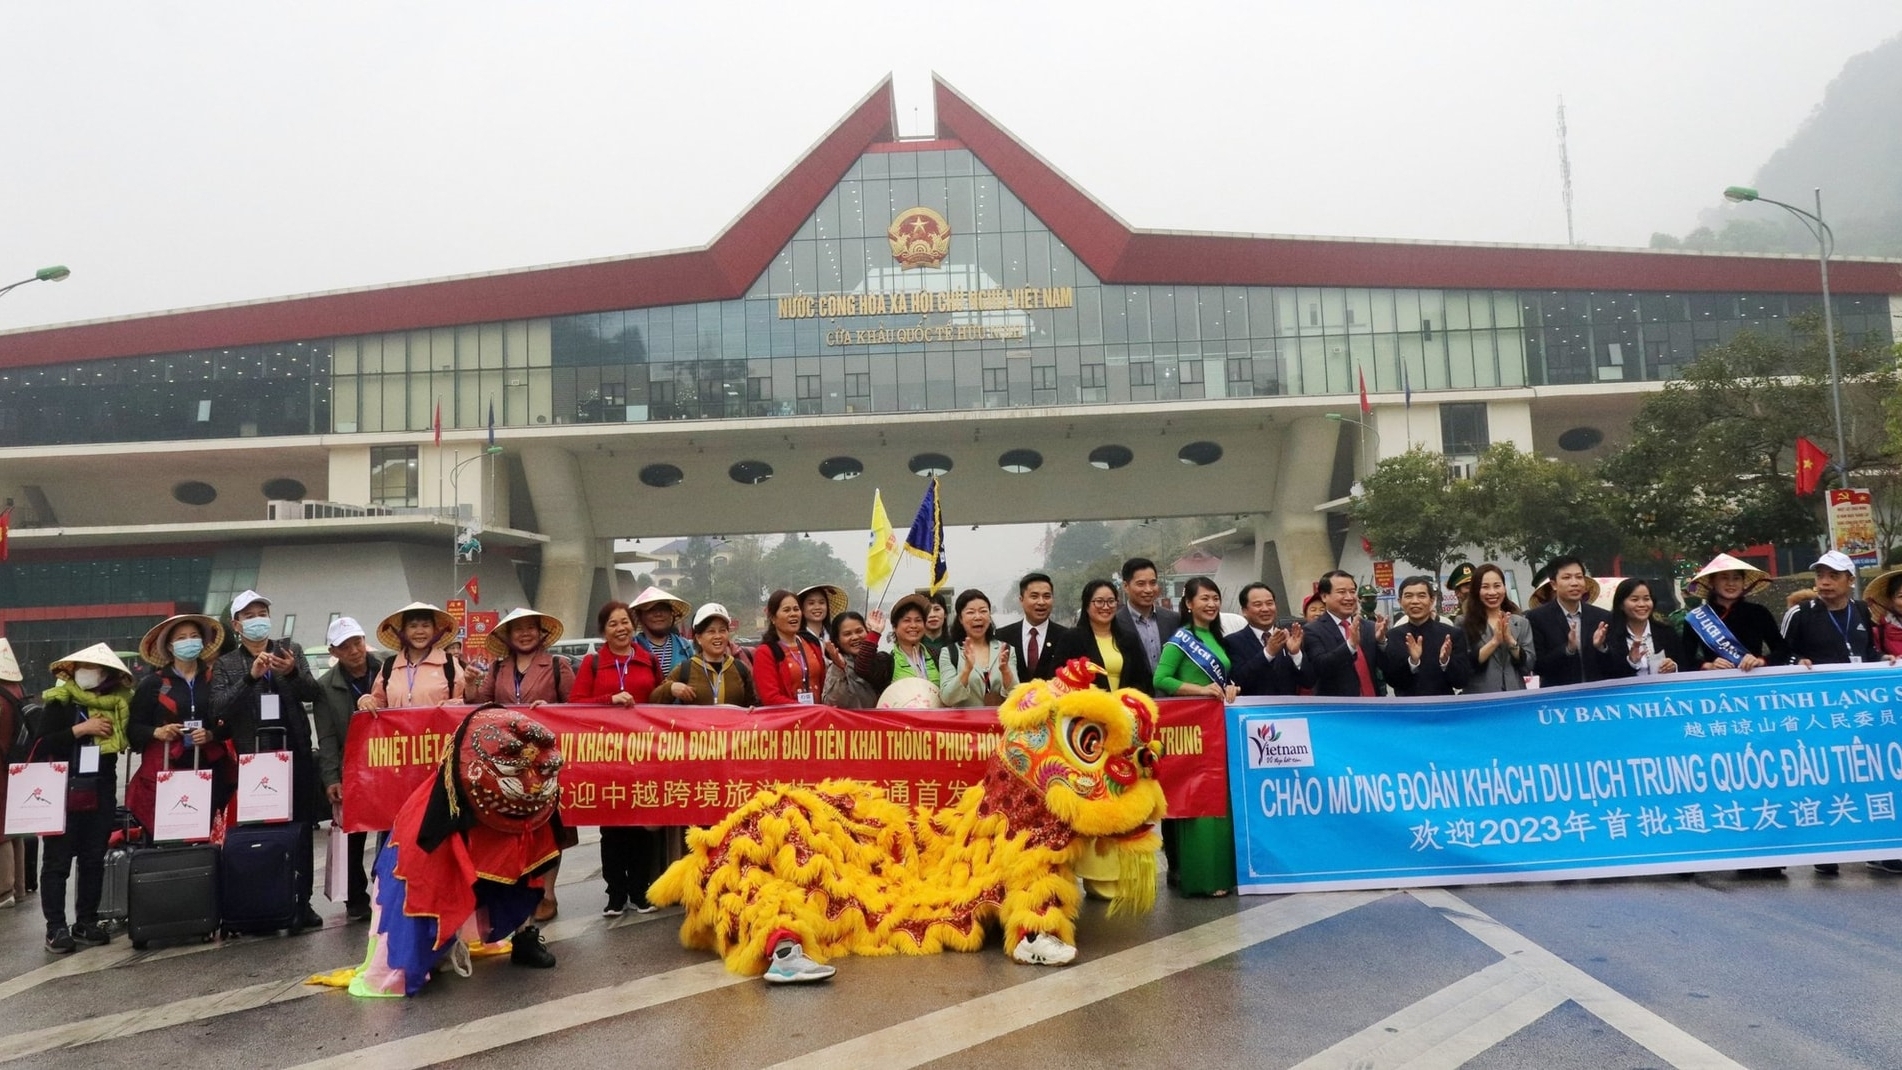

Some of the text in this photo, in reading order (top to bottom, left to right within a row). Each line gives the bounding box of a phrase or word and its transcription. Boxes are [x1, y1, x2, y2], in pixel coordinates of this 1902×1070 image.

[778, 290, 816, 319] NƯỚC
[818, 293, 856, 323] CỘNG
[910, 289, 935, 319] HỘI
[1012, 283, 1040, 314] VIỆT
[1042, 286, 1072, 309] NAM
[896, 320, 933, 344] QUỐC
[936, 319, 954, 341] TẾ
[1690, 607, 1707, 620] DU
[1700, 618, 1722, 638] LỊCH
[1174, 630, 1191, 643] DU
[1189, 640, 1212, 661] LỊCH
[1538, 704, 1570, 725] ỦY
[1575, 704, 1621, 723] BAN
[1627, 696, 1694, 719] NHÂN
[1700, 692, 1749, 714] DÂN
[1755, 689, 1816, 711] TỈNH
[1821, 686, 1889, 710] LẠNG
[368, 730, 409, 773] NHIỆT
[411, 728, 441, 770] LIỆT
[561, 732, 574, 769] VỊ
[577, 726, 624, 762] KHÁCH
[627, 725, 655, 765] QUÝ
[657, 719, 685, 762] CỦA
[688, 725, 728, 761] ĐOÀN
[731, 723, 779, 760] KHÁCH
[782, 719, 811, 761] ĐẦU
[814, 724, 846, 760] TIÊN
[850, 730, 882, 760] KHAI
[886, 725, 932, 761] THÔNG
[936, 731, 973, 767] PHỤC
[1159, 725, 1203, 755] TRUNG
[1249, 736, 1309, 766] Vietnam
[1260, 769, 1323, 818] CHÀO
[1328, 767, 1396, 814] MỪNG
[1398, 763, 1460, 811] ĐOÀN
[1463, 759, 1538, 807] KHÁCH
[1542, 763, 1572, 802] DU
[1575, 759, 1627, 807] LỊCH
[1627, 754, 1709, 797] TRUNG
[1710, 742, 1779, 794] QUỐC
[1781, 739, 1830, 787] ĐẦU
[1831, 735, 1885, 784] TIÊN
[1409, 791, 1896, 852] 欢迎2023年首批通过友谊关国
